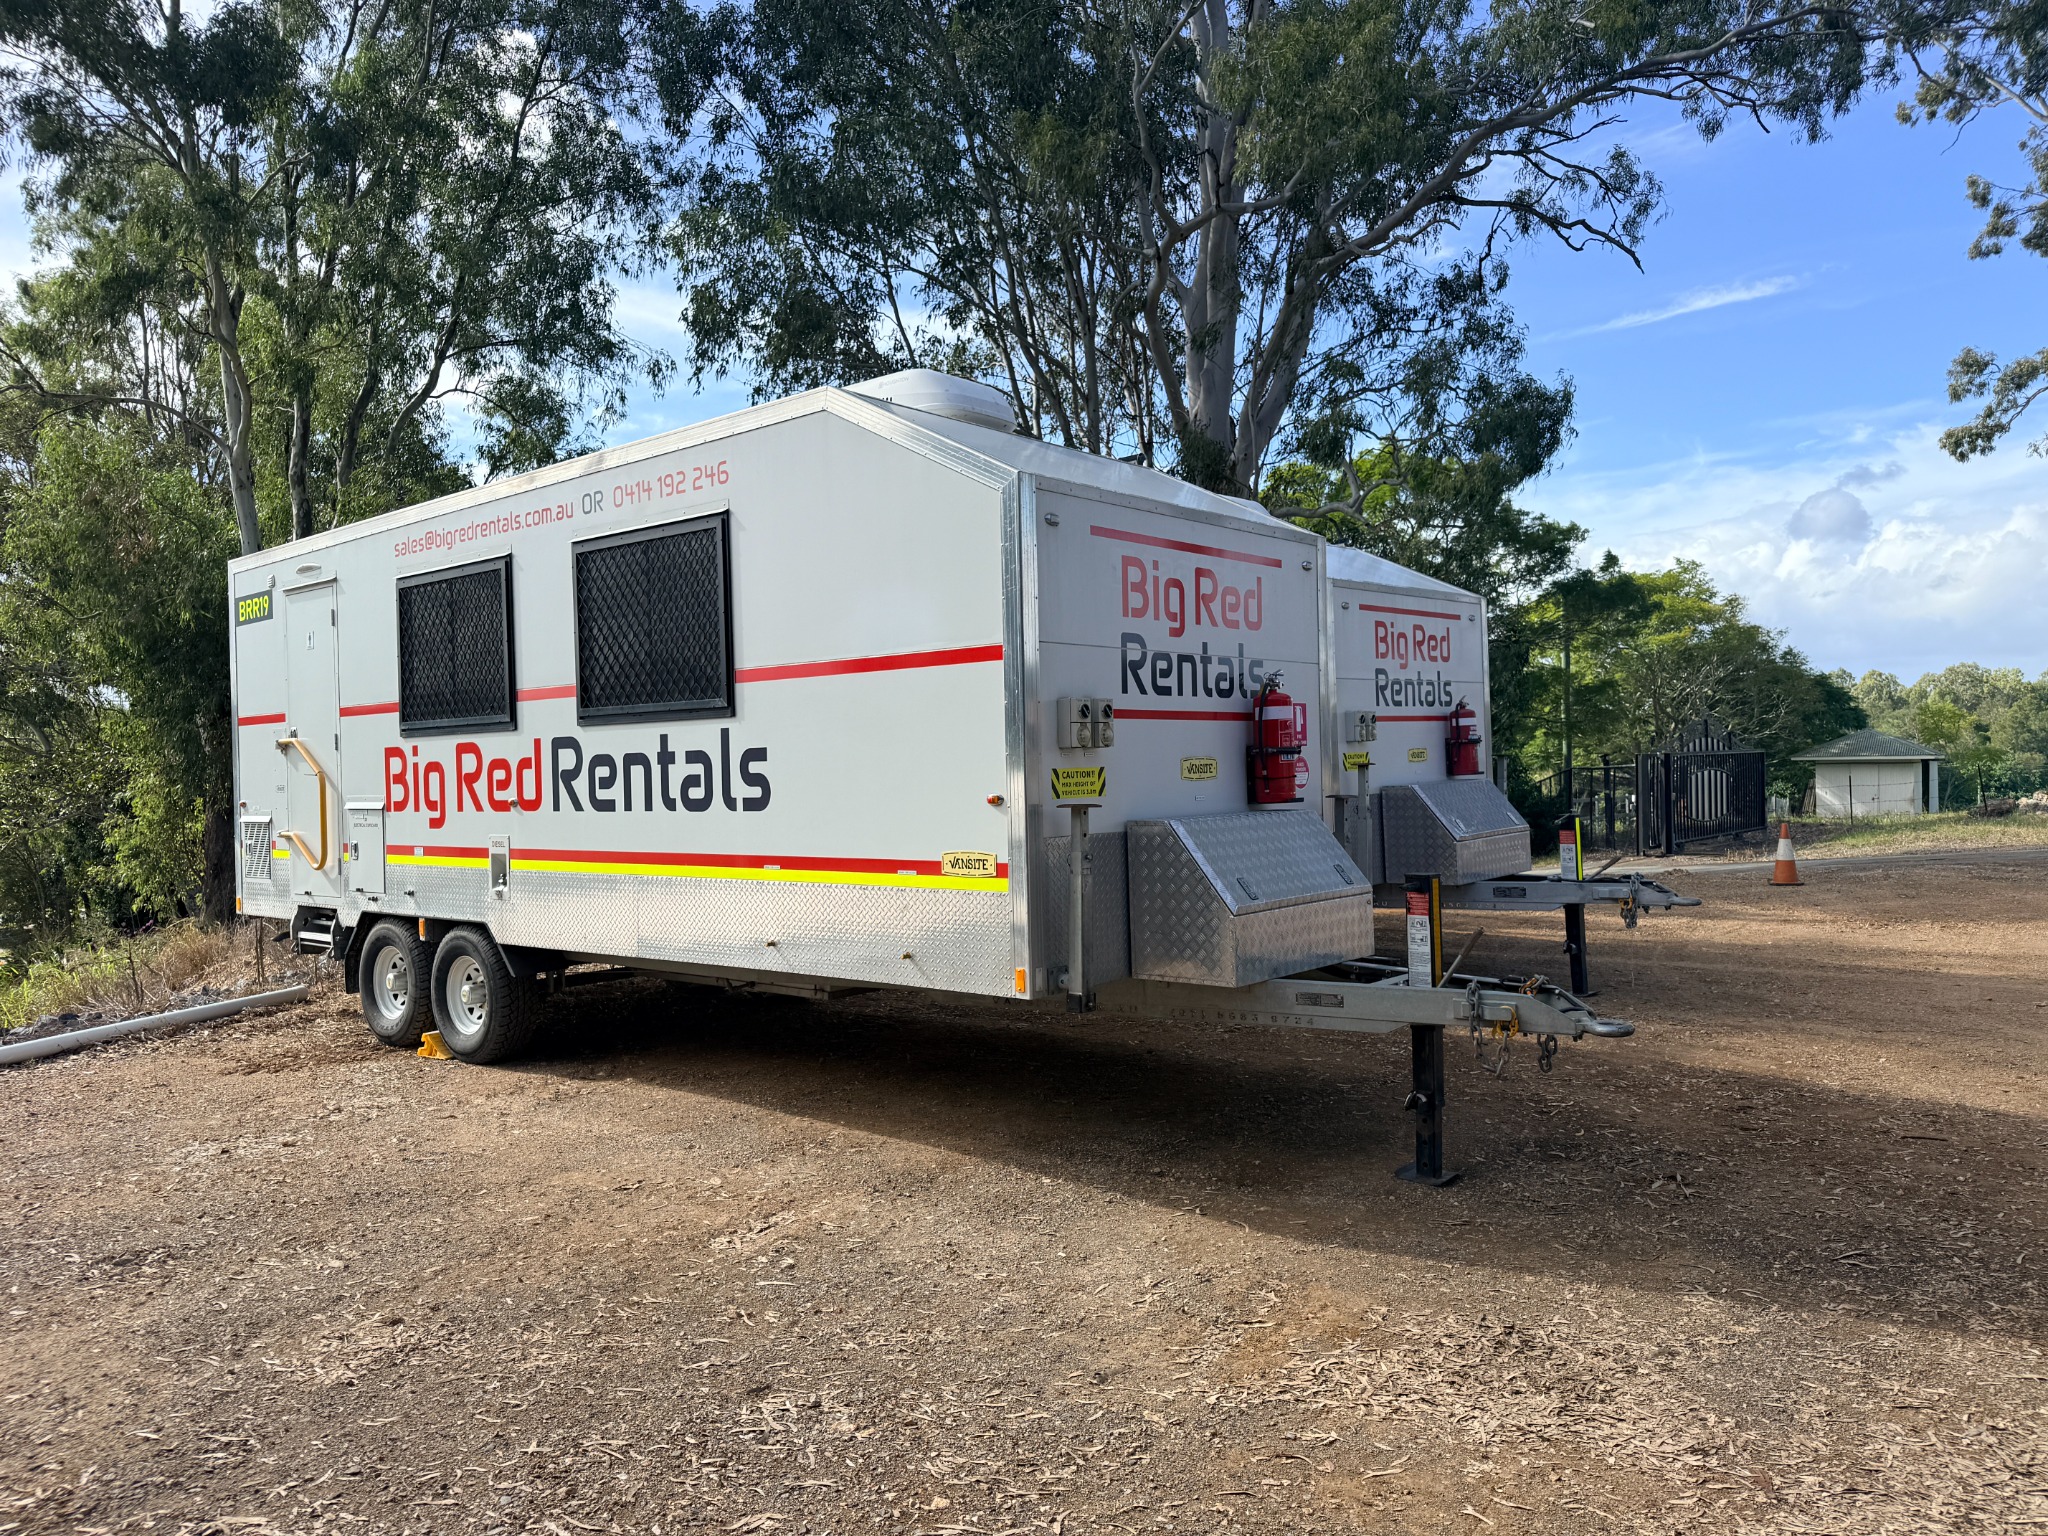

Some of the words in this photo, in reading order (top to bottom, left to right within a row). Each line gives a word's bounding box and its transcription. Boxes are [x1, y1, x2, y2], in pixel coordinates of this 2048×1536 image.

[394, 501, 574, 558] sales@bigredrentals.com.au
[582, 490, 604, 514] OR
[613, 479, 652, 508] 0414
[657, 471, 686, 498] 192
[693, 460, 729, 490] 246
[239, 595, 268, 622] BRR19
[1121, 555, 1185, 638] Big
[1195, 567, 1263, 631] Red
[1121, 632, 1264, 699] Rentals
[1375, 620, 1408, 670] Big
[1413, 624, 1450, 662] Red
[1375, 668, 1453, 707] Rentals
[384, 745, 446, 829] Big
[455, 738, 542, 812] Red
[551, 728, 771, 812] Rentals
[1186, 762, 1214, 775] VANSITE
[949, 856, 989, 871] VANSITE
